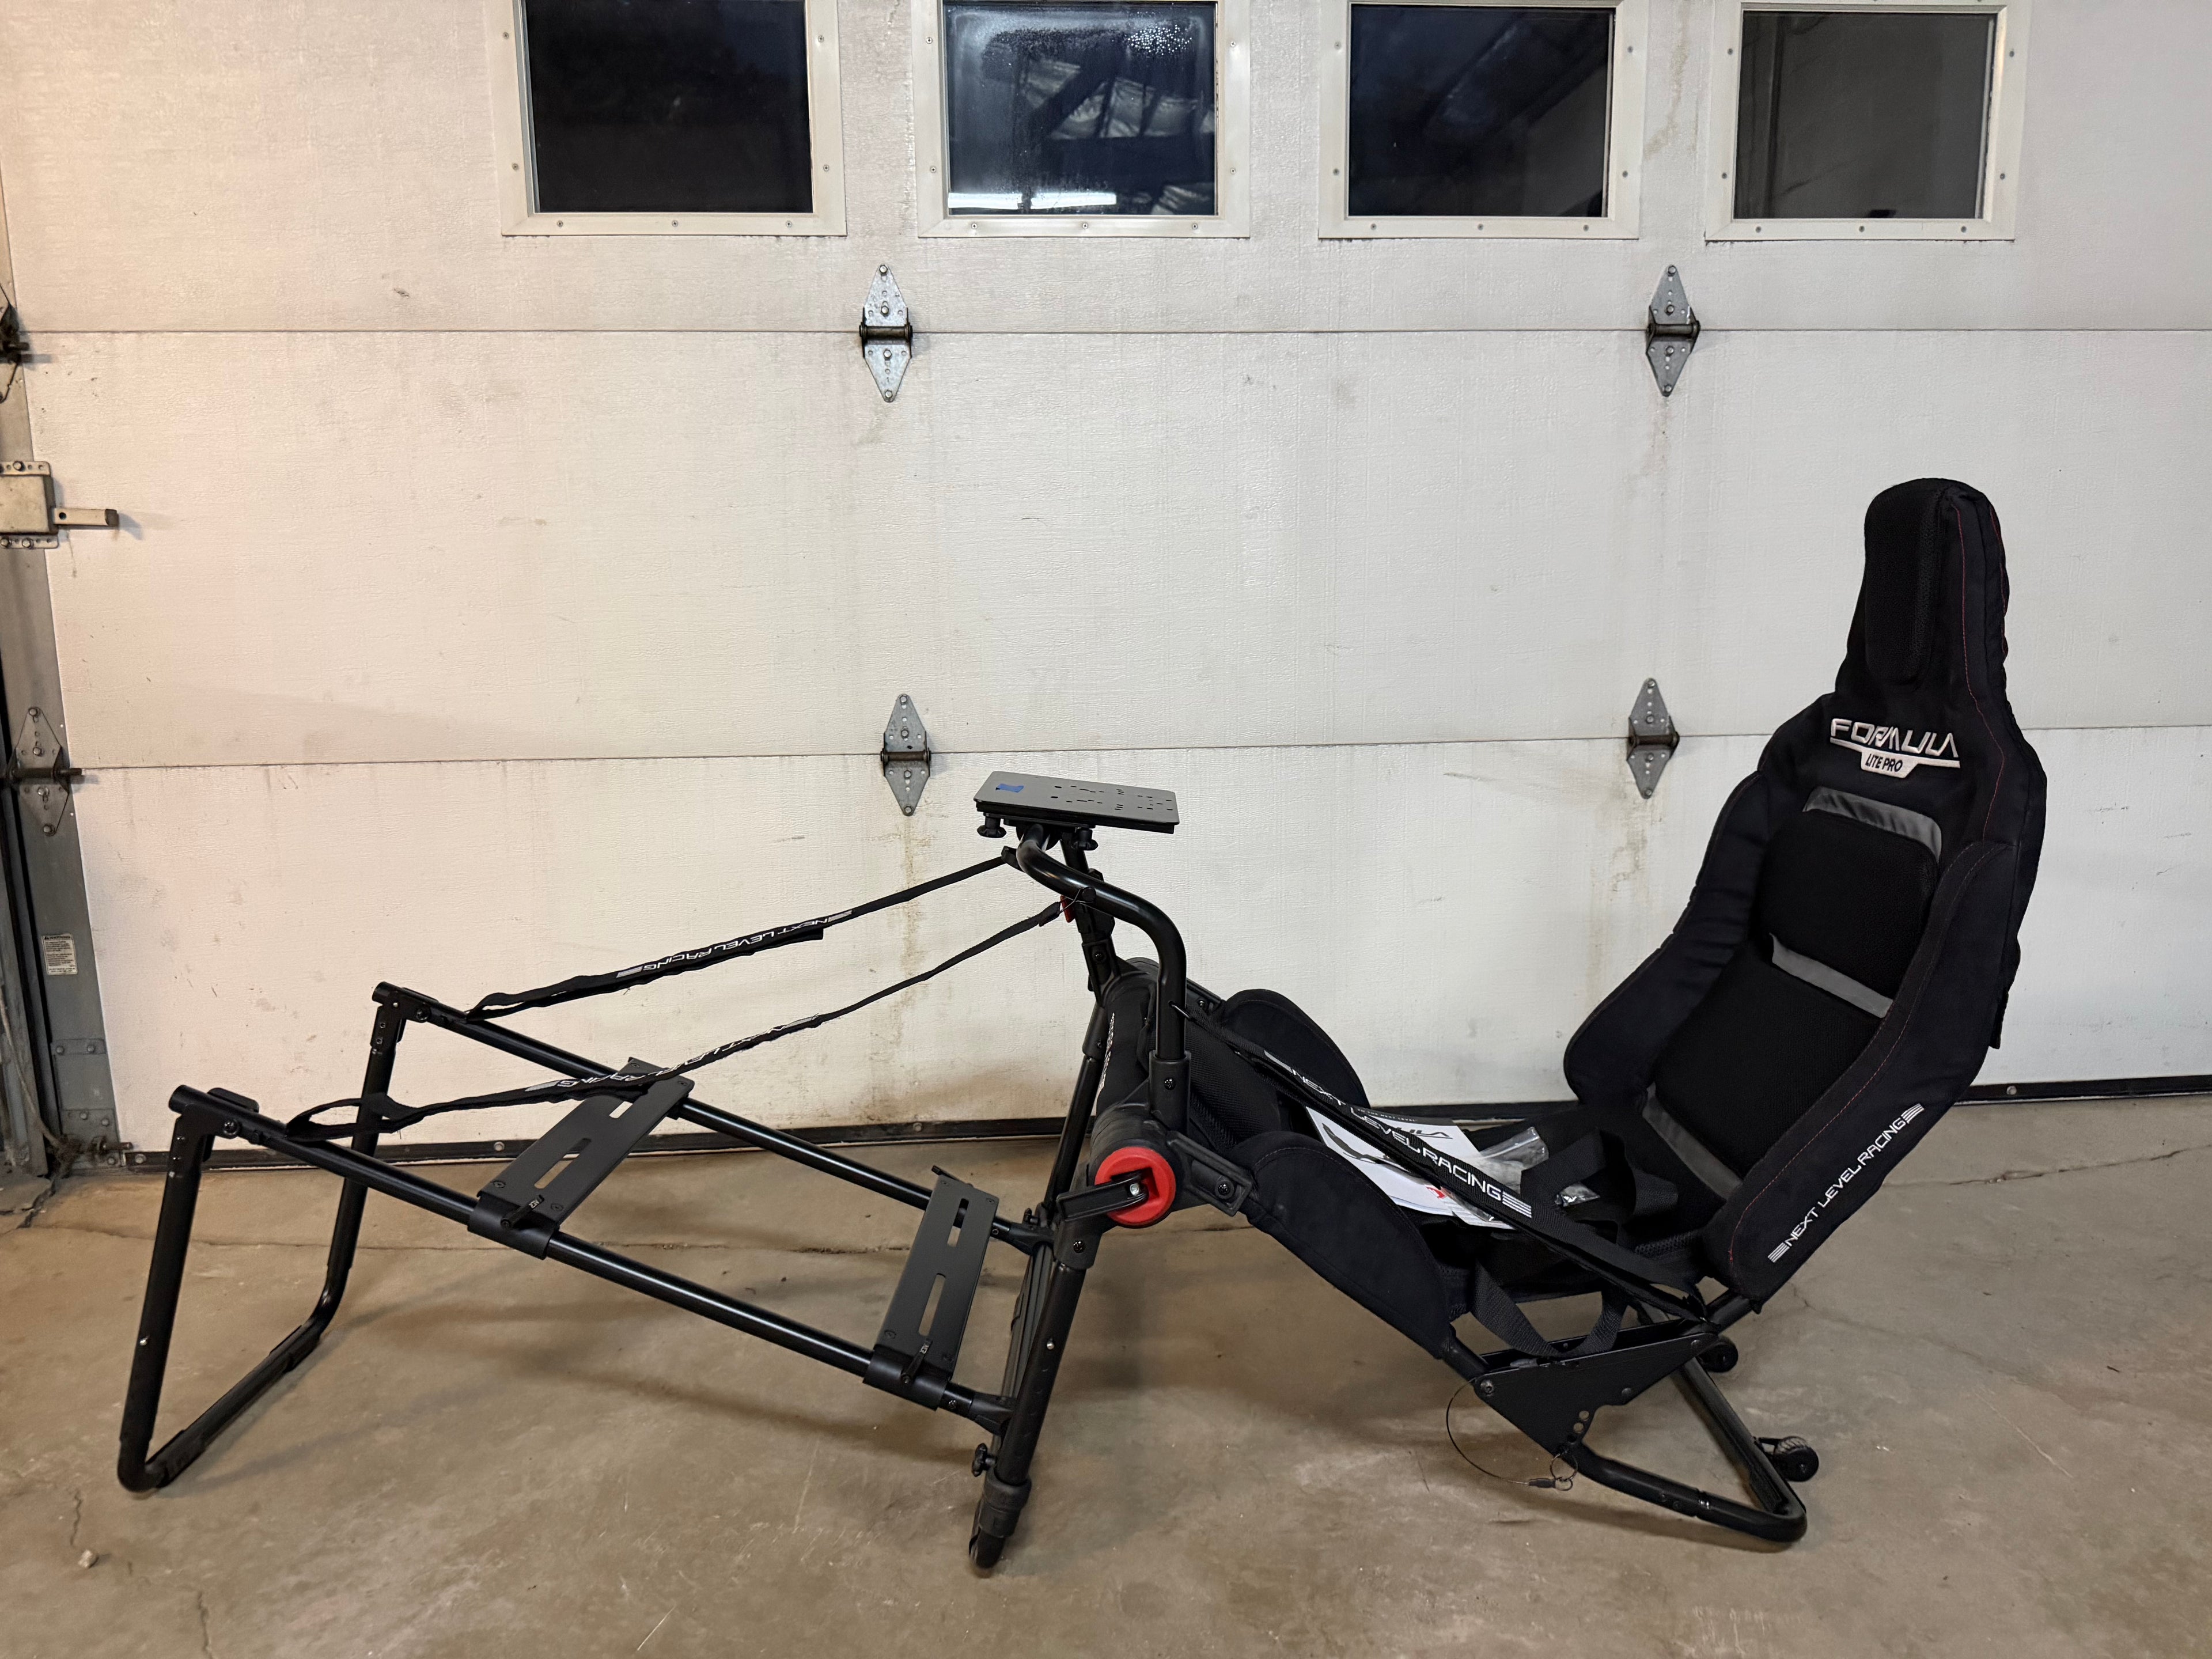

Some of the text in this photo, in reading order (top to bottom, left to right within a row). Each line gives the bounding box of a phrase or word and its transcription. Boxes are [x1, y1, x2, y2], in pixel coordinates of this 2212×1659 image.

[1830, 718, 1959, 758] FORMULA
[1865, 753, 1903, 772] LITE PRO
[643, 918, 828, 971] NEXT LEVEL RACING
[1291, 1068, 1502, 1201] NEXT LEVEL RACING
[1785, 1118, 1906, 1247] NEXT LEVEL RACING
